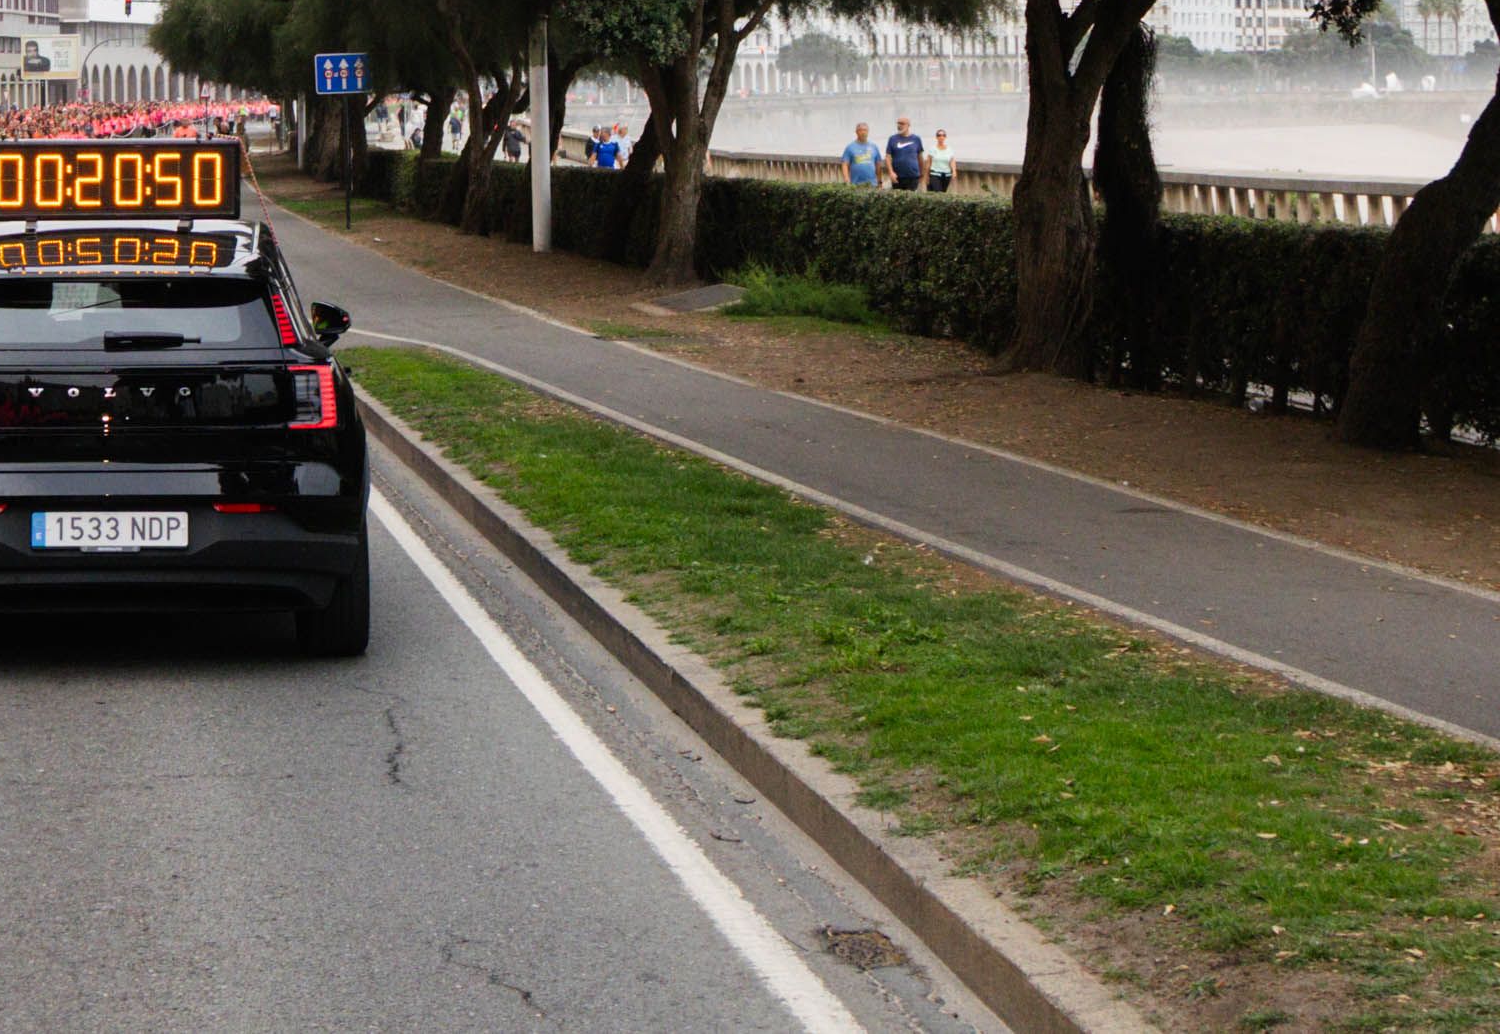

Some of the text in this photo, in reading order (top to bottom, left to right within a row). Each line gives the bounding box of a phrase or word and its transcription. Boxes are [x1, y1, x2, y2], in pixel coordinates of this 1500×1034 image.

[28, 387, 191, 397] VOLVO
[56, 516, 119, 541] 1533
[131, 516, 181, 541] NDP
